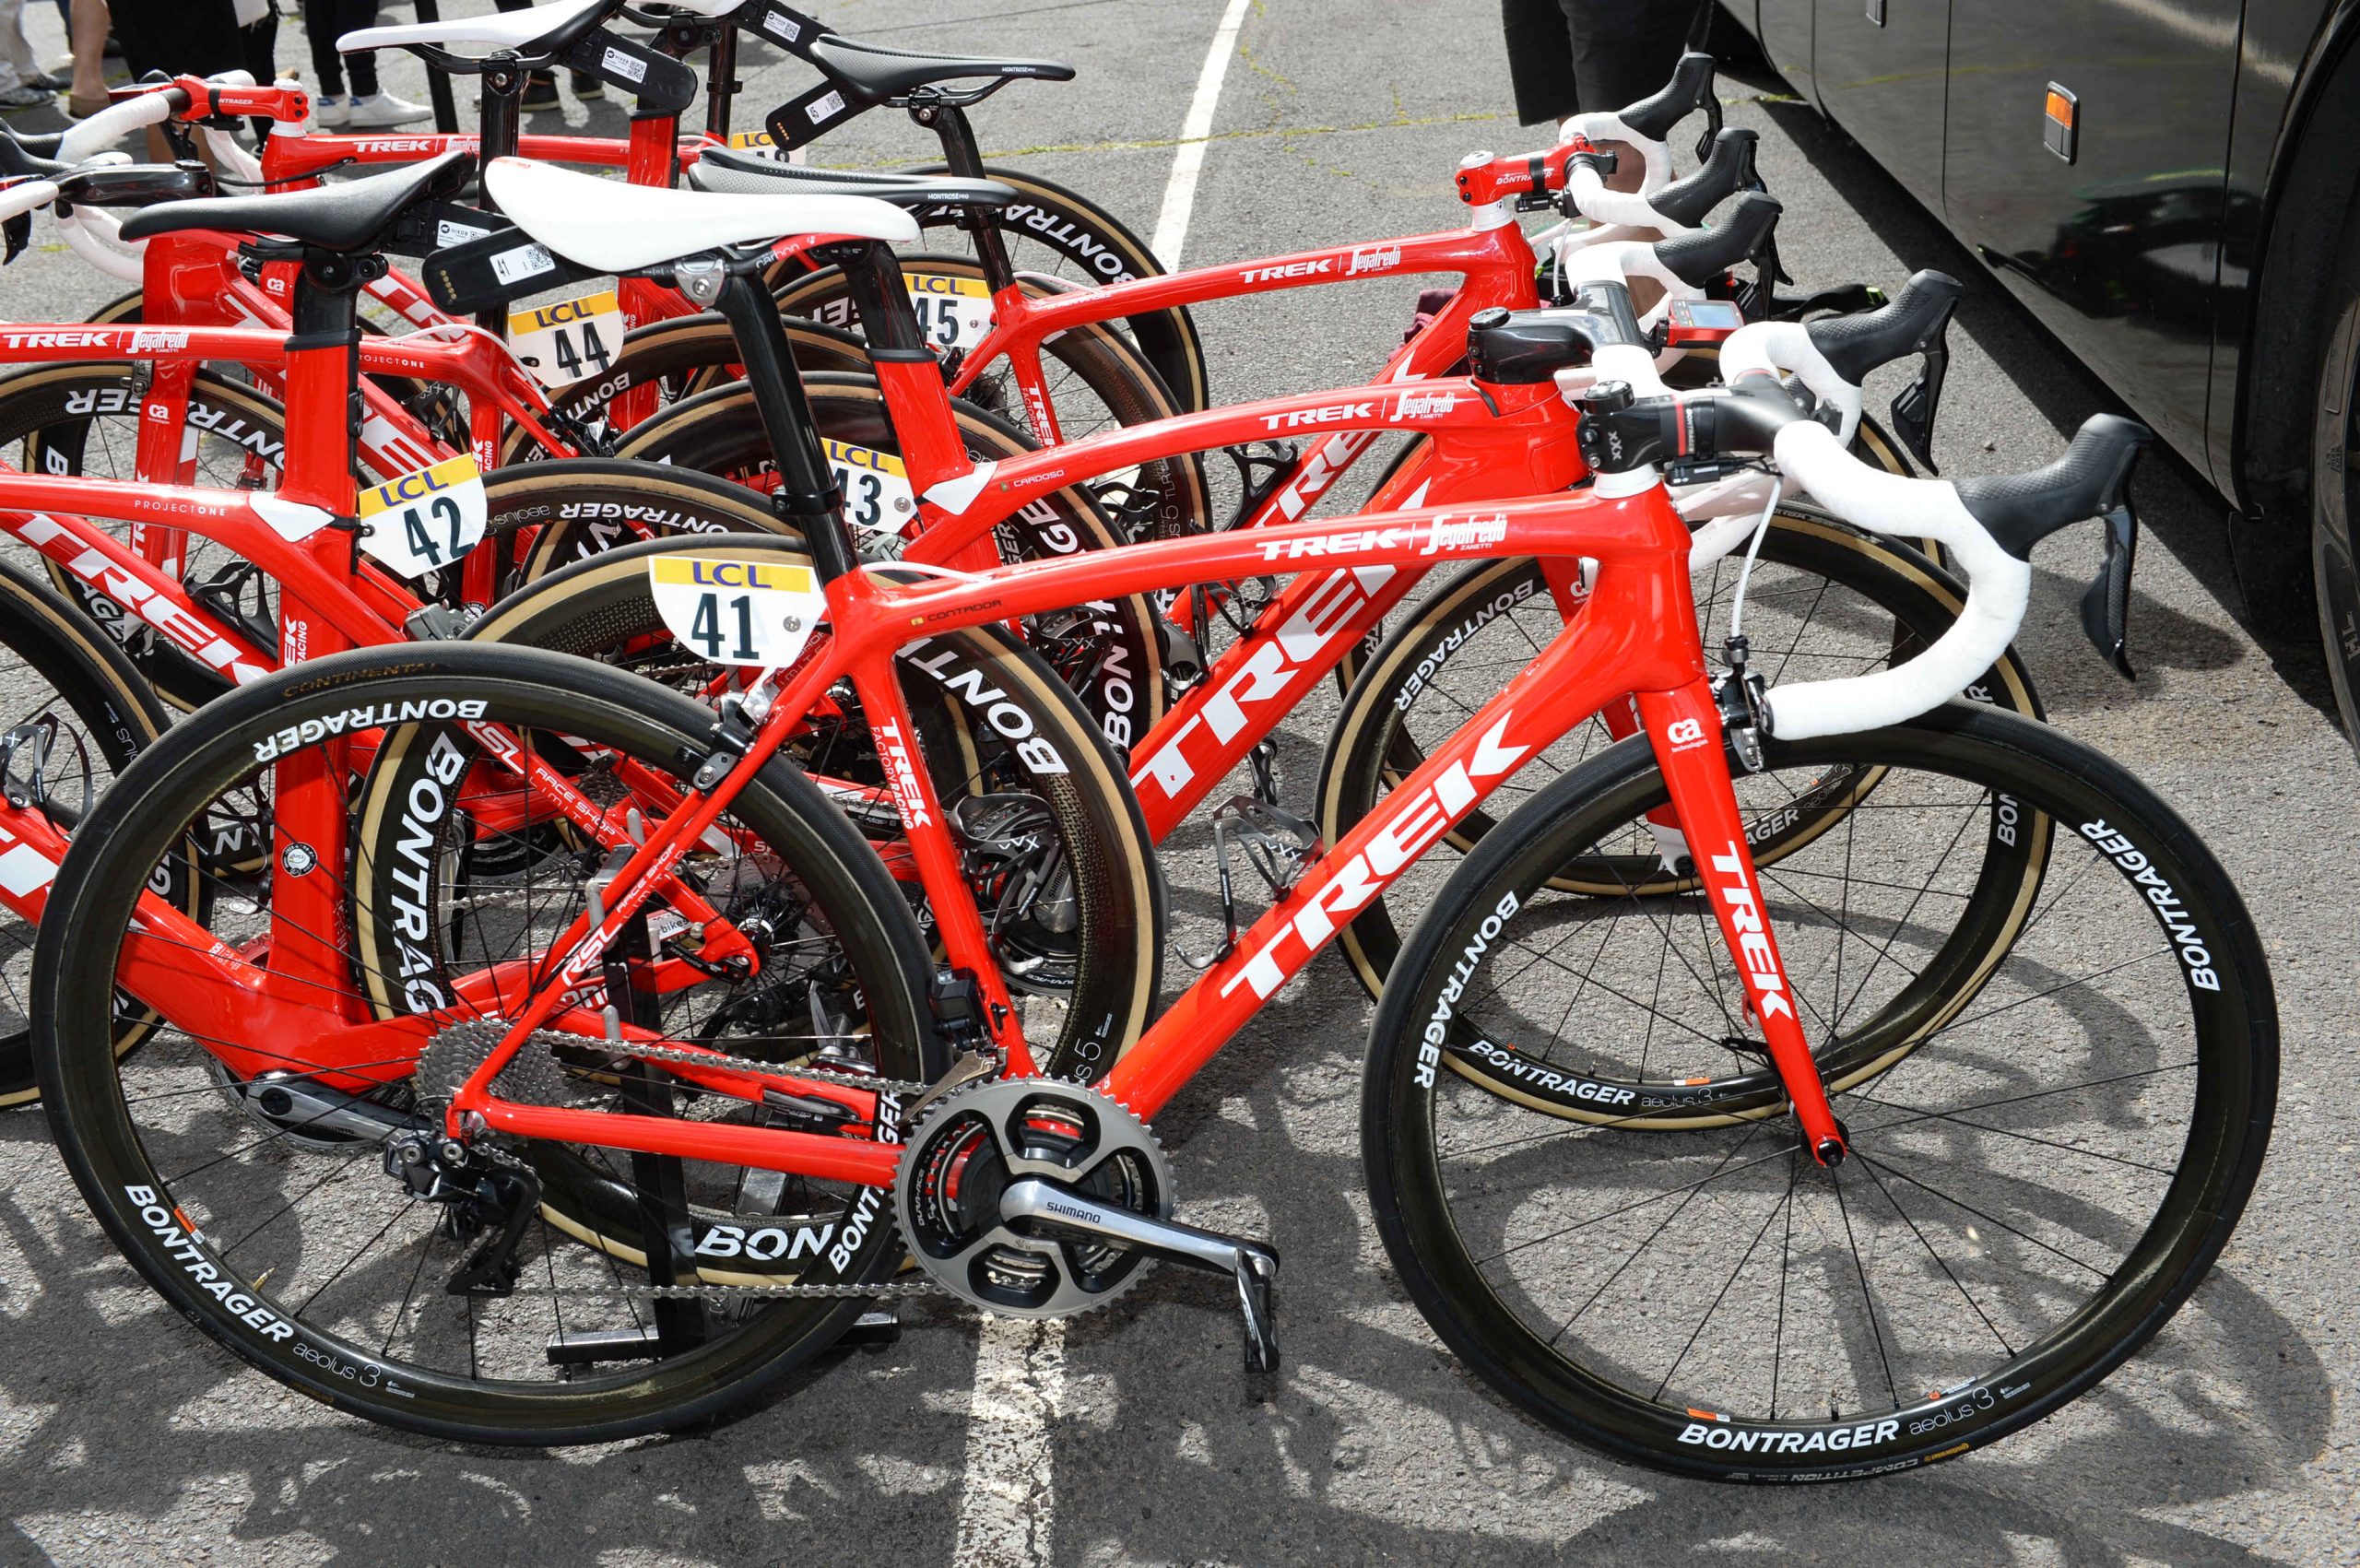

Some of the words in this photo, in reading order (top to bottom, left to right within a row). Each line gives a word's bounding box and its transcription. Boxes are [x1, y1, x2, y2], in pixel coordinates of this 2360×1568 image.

[218, 98, 254, 106] NTRAGER
[353, 140, 431, 153] TREK
[743, 132, 772, 147] LC
[1496, 170, 1554, 185] BONTRAR
[756, 243, 799, 270] carbon
[1239, 259, 1333, 284] TREK
[1345, 245, 1401, 277] Segafredo
[914, 276, 965, 296] LCL
[536, 301, 594, 328] LCL
[915, 297, 959, 345] 45
[3, 332, 112, 348] TREK
[126, 328, 191, 354] Segafredo
[555, 322, 610, 378] 44
[1259, 402, 1375, 430] TREK
[1389, 390, 1456, 422] Segafredo
[485, 440, 494, 472] ACING
[830, 442, 890, 473] LCL
[379, 471, 450, 507] LCL
[834, 467, 883, 526] 43
[1013, 469, 1065, 488] CARDOSO
[404, 496, 476, 566] 42
[559, 502, 730, 534] ONTRAGER
[1256, 528, 1404, 561] TREK
[1420, 513, 1508, 556] Segafredo
[1460, 542, 1493, 551] ZANETTI
[692, 561, 773, 589] LCL
[690, 592, 760, 661] 41
[927, 599, 1002, 622] CONTADOR
[1393, 578, 1534, 711] BONTRAGER
[254, 698, 489, 763] BONTRAGER
[1667, 718, 1703, 745] ca
[1671, 737, 1708, 753] technologies
[870, 725, 899, 783] FACTORY
[890, 783, 914, 831] RACING
[882, 716, 933, 829] TREK
[528, 775, 609, 847] LIMITED
[536, 766, 575, 808] RACE
[576, 800, 618, 837] SHOP
[391, 730, 466, 1014] BONTRAG
[1220, 710, 1532, 1001] TREK
[616, 879, 648, 914] RACE
[645, 842, 676, 879] SHOP
[2080, 819, 2221, 993] BONTRAGER
[1712, 840, 1794, 1020] TREK
[561, 923, 623, 987] RSL
[1413, 890, 1519, 1090] BONTRAGER
[1074, 1037, 1102, 1061] 5
[1469, 1039, 1636, 1106] BONTRAGER
[1641, 1095, 1694, 1108] aeolus
[1697, 1087, 1713, 1105] 3
[1046, 1200, 1102, 1224] SHIMANO
[124, 1185, 294, 1343] BONTRAGER
[292, 1341, 358, 1381] aeolus
[359, 1364, 382, 1388] 3
[1678, 1419, 1900, 1454] BONTRAGER
[1909, 1404, 1976, 1436] aeolus
[1972, 1386, 1995, 1410] 3
[1789, 1457, 1919, 1482] COMPETITION
